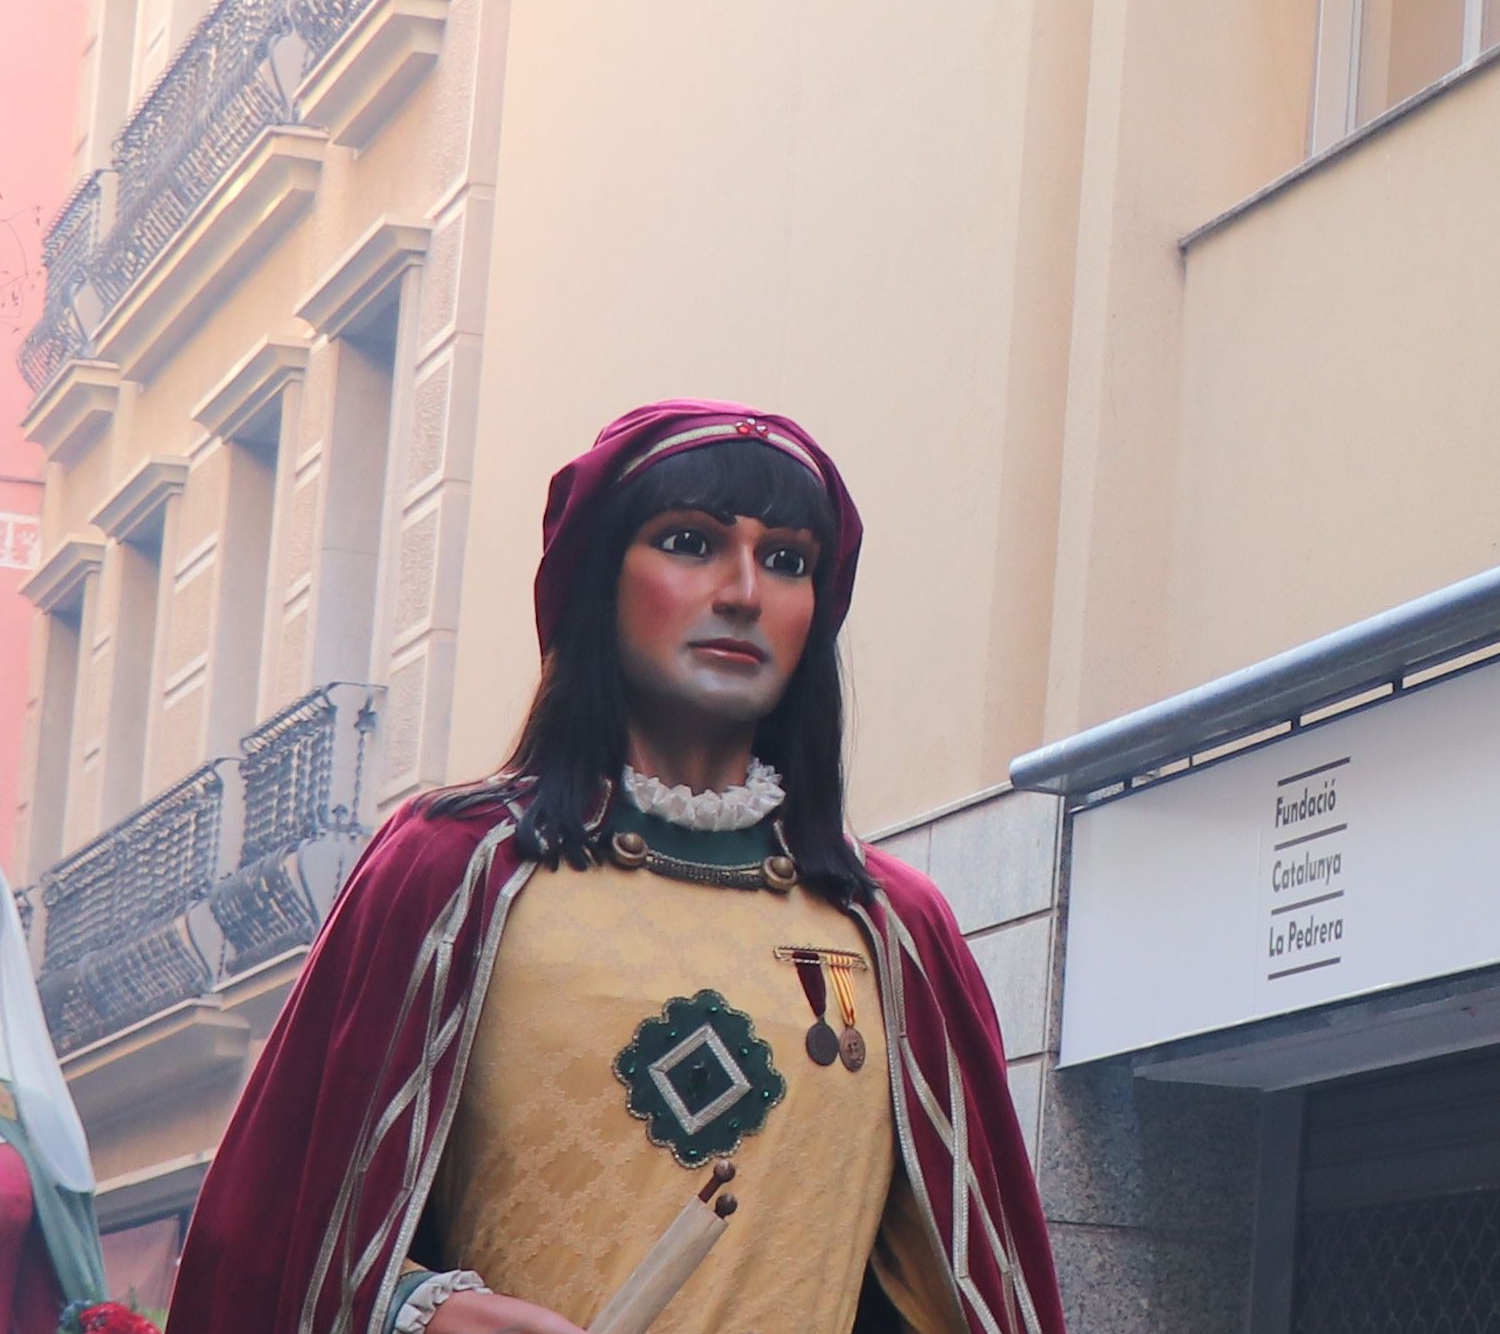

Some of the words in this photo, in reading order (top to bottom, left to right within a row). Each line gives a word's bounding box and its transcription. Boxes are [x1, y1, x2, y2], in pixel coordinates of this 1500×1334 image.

[1274, 778, 1337, 828] Fundació
[1271, 851, 1342, 893] Catalunya
[1267, 926, 1284, 958] La
[1287, 915, 1343, 953] Pedrera
